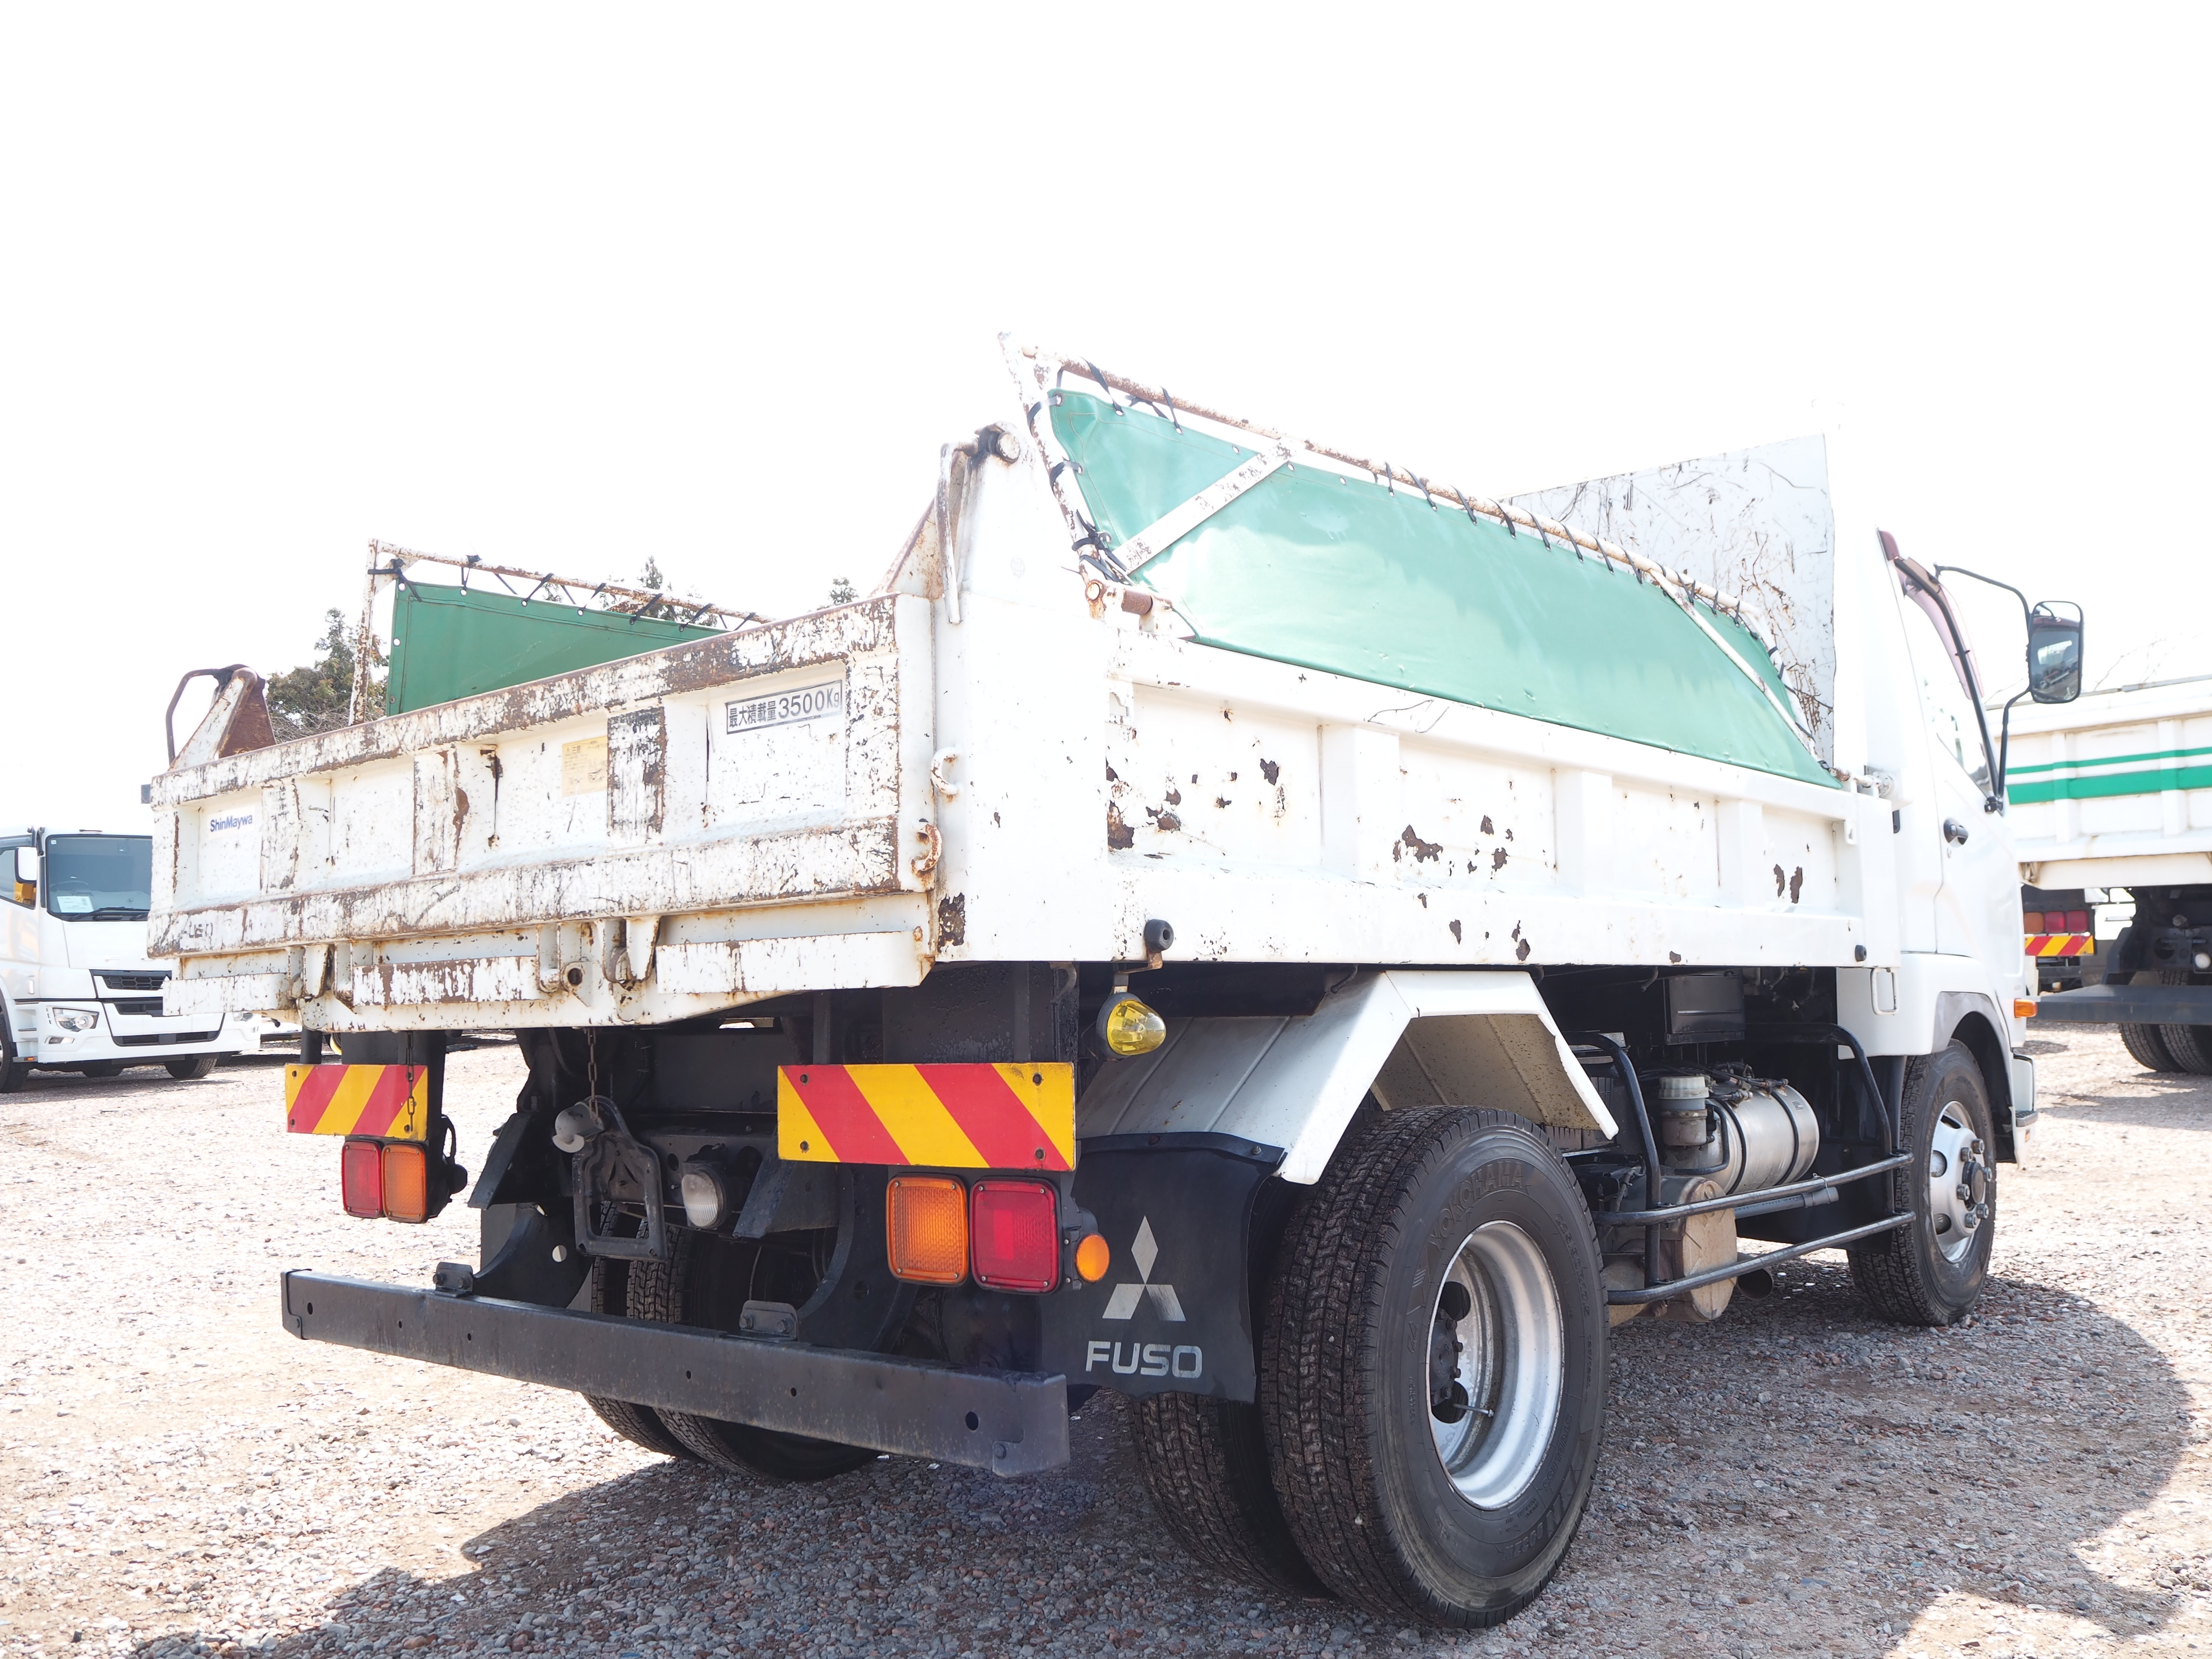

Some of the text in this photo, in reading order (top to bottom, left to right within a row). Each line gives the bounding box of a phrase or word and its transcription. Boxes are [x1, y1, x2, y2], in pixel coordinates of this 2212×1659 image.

[778, 688, 840, 719] 3500Kg
[210, 815, 252, 832] ShinMaywa
[1429, 1161, 1524, 1251] YOKOHAMA
[1085, 1340, 1202, 1379] FUSO
